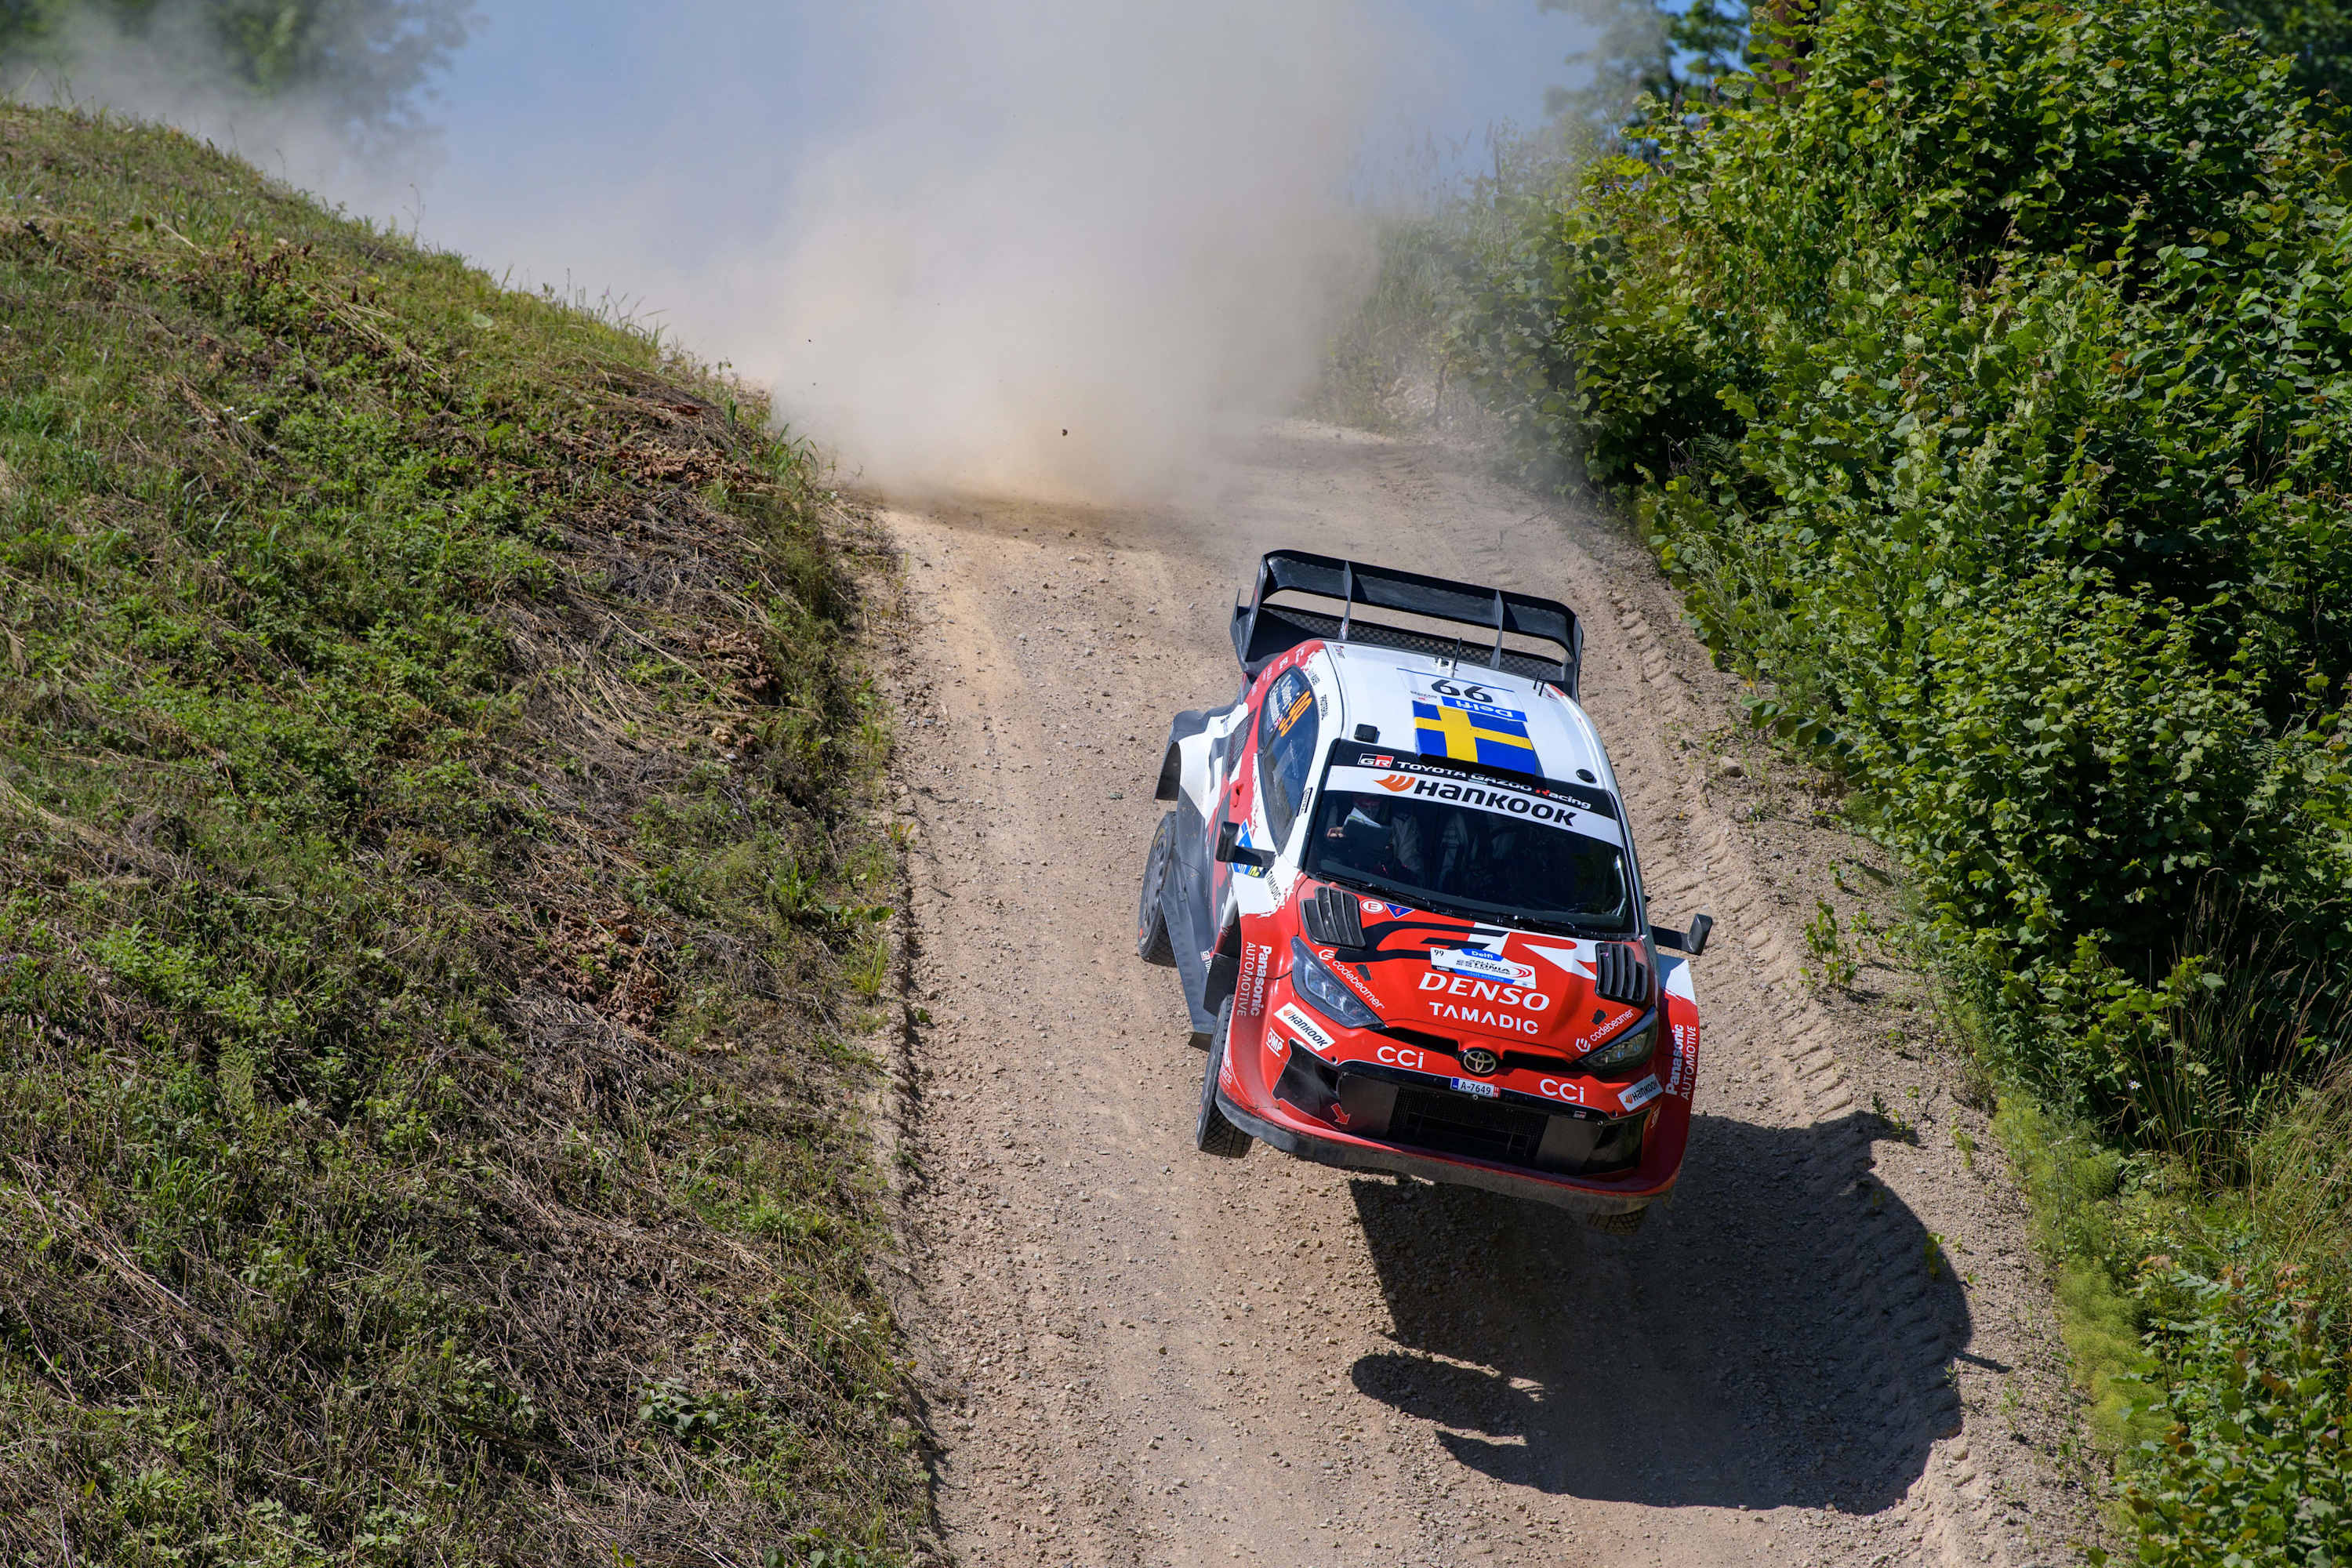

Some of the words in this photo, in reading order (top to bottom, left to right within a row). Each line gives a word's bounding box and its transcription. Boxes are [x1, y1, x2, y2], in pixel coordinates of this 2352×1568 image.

[1455, 700, 1514, 718] Delfi
[1359, 756, 1392, 768] GR
[1396, 761, 1467, 778] TOYOTA
[1469, 773, 1533, 792] GAZOO
[1535, 788, 1592, 810] Racing
[1456, 960, 1511, 973] ESTONIA
[1472, 950, 1494, 960] Delfi
[1236, 942, 1256, 1017] AUTOMOTIVE
[1250, 945, 1272, 1017] Panasonic
[1332, 960, 1384, 1009] codebeamer
[1418, 972, 1550, 1011] DENSO
[1428, 1001, 1539, 1035] TAMADIC
[1590, 1009, 1634, 1042] codebeamer
[1267, 1032, 1284, 1052] OMP
[1377, 1046, 1424, 1069] CCi
[1665, 1024, 1684, 1096] Panasonic
[1681, 1025, 1697, 1101] AUTOMOTIVE
[1461, 1081, 1491, 1094] A-7649
[1540, 1078, 1584, 1103] CCi
